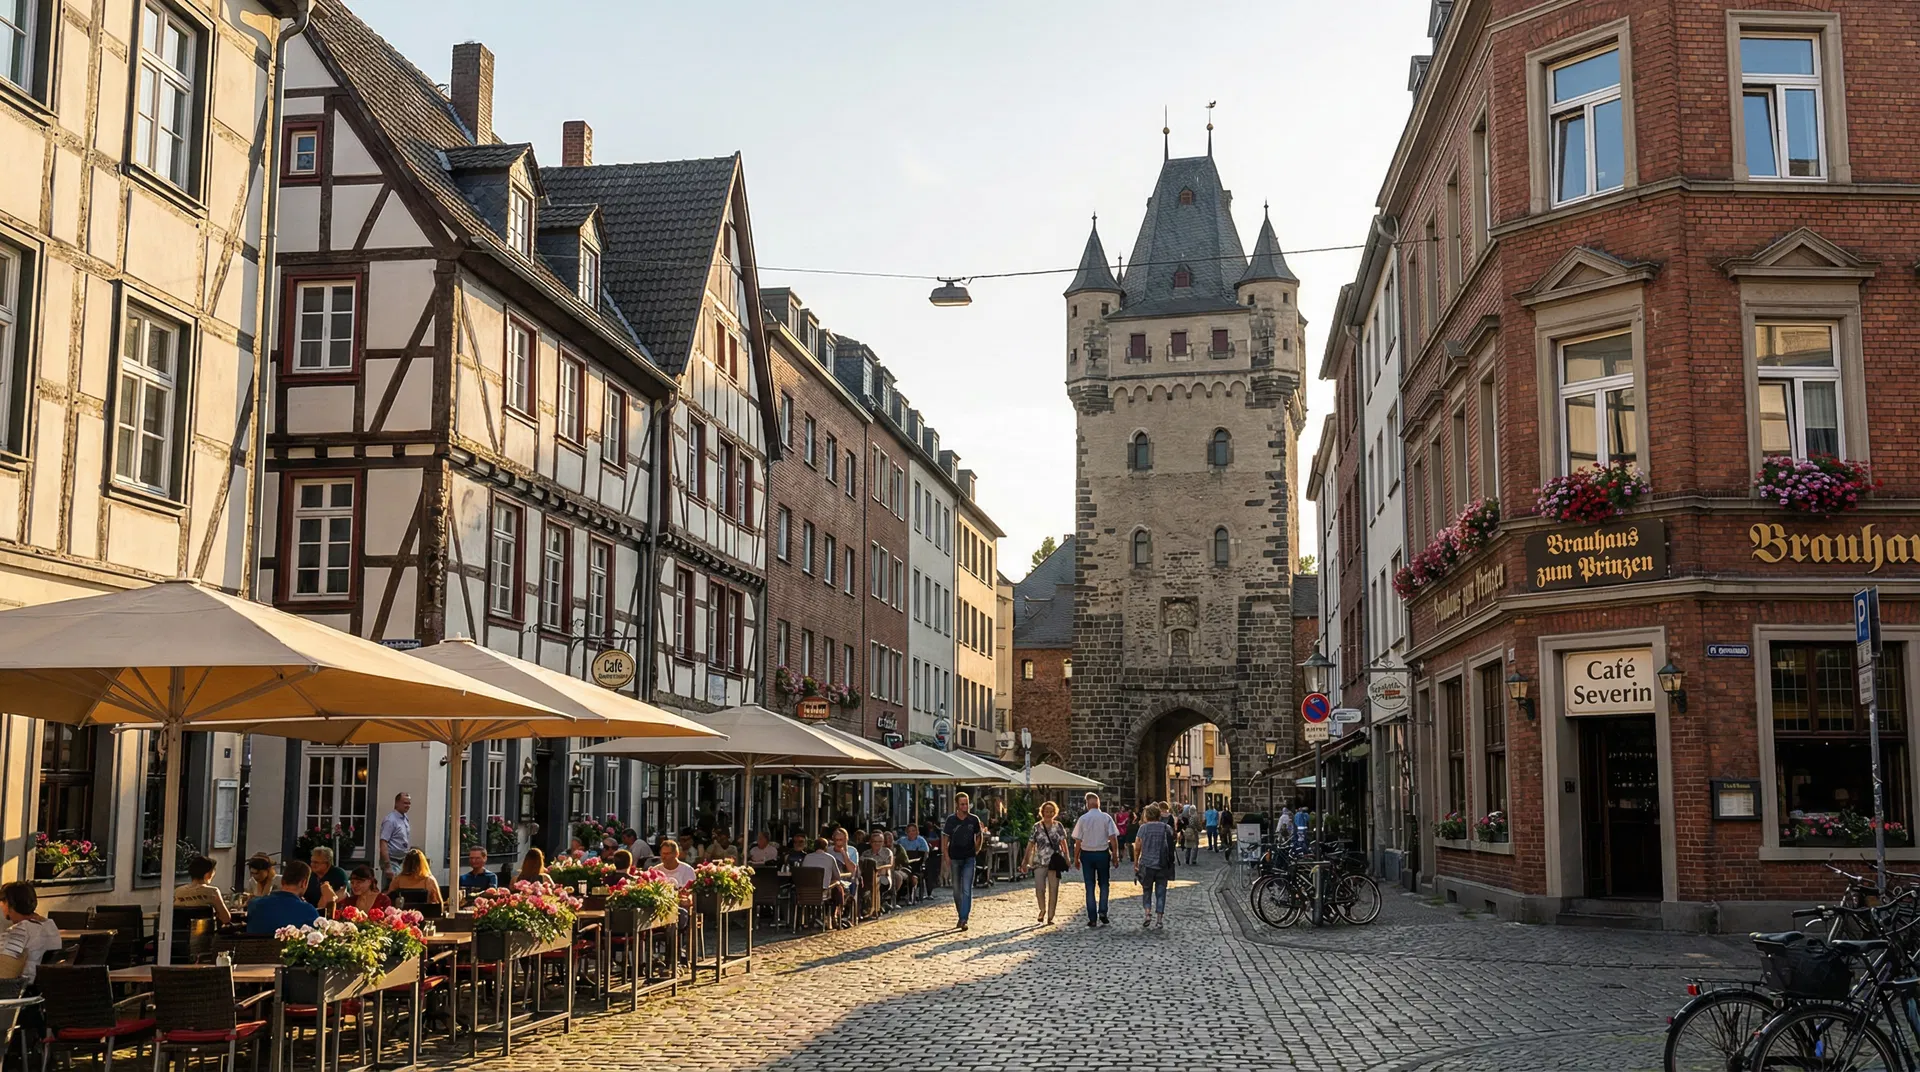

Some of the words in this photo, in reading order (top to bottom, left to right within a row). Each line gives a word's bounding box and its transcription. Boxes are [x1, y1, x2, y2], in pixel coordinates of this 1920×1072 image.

[1546, 526, 1639, 555] Brauhaus
[1536, 563, 1573, 588] zum
[1577, 555, 1654, 583] Prinzen
[1857, 599, 1866, 637] P
[1586, 657, 1636, 680] Café
[1573, 681, 1652, 705] Severin
